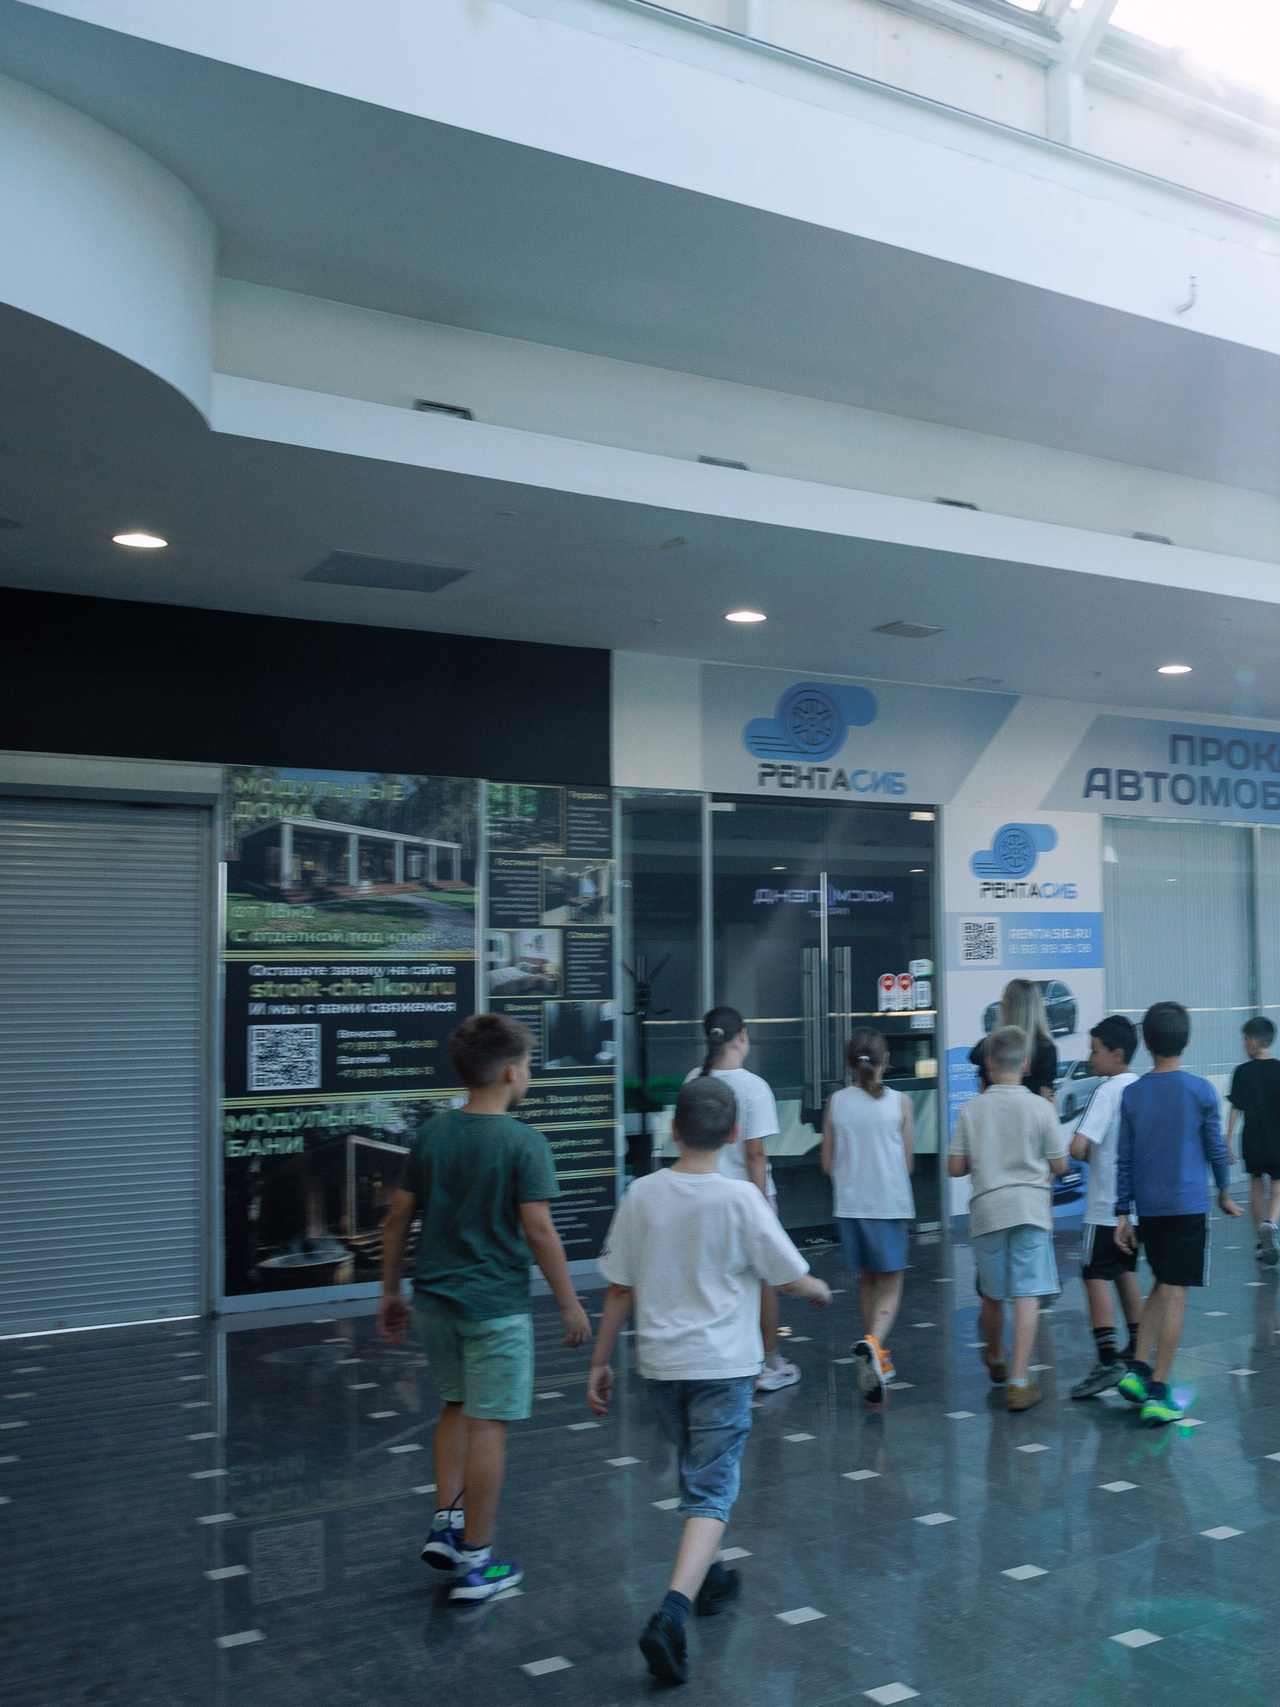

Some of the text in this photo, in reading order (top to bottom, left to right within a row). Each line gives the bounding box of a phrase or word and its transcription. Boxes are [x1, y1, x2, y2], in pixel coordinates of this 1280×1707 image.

[232, 775, 405, 801] МОДУЛЬНЫЕ
[758, 763, 908, 796] РЕНТАСИБ
[232, 801, 317, 821] ДОМА
[980, 881, 1079, 899] РЕНТАСИБ
[249, 929, 344, 945] отделкой
[346, 932, 384, 944] под
[249, 964, 456, 978] Оставьте заявку на сайте
[249, 978, 456, 998] stroit-chalkov.ru
[248, 1002, 457, 1015] И мы с вами свяжемся
[226, 1107, 400, 1133] МОДУЛЬНЫЕ
[226, 1136, 304, 1158] БАНИ
